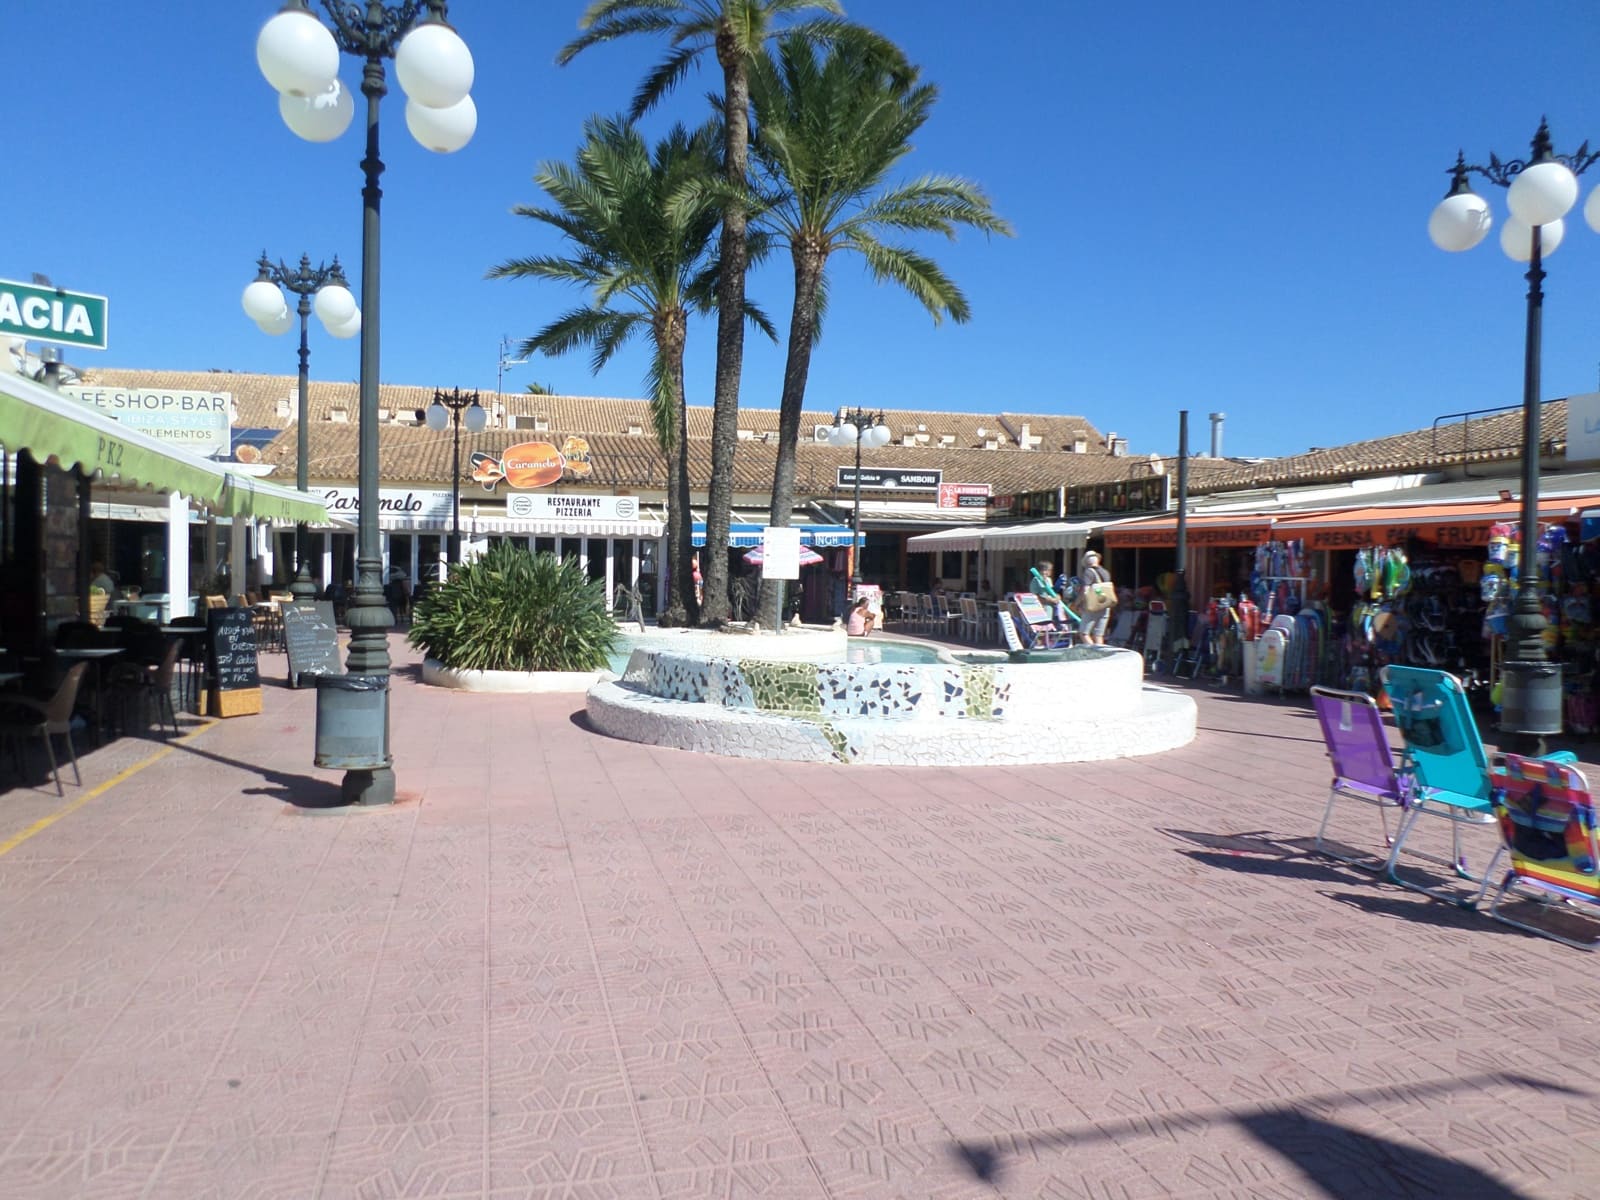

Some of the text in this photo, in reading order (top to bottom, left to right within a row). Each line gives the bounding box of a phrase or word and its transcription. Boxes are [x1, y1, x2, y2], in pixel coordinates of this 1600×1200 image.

[0, 292, 94, 336] ACIA
[97, 437, 124, 466] PK2
[507, 458, 556, 470] Caramelo
[325, 489, 422, 512] Carmelo
[547, 497, 601, 508] RESTAURANTE
[555, 507, 592, 517] PIZZERIA
[1315, 528, 1374, 546] PRENSA
[1437, 525, 1490, 546] FRUT
